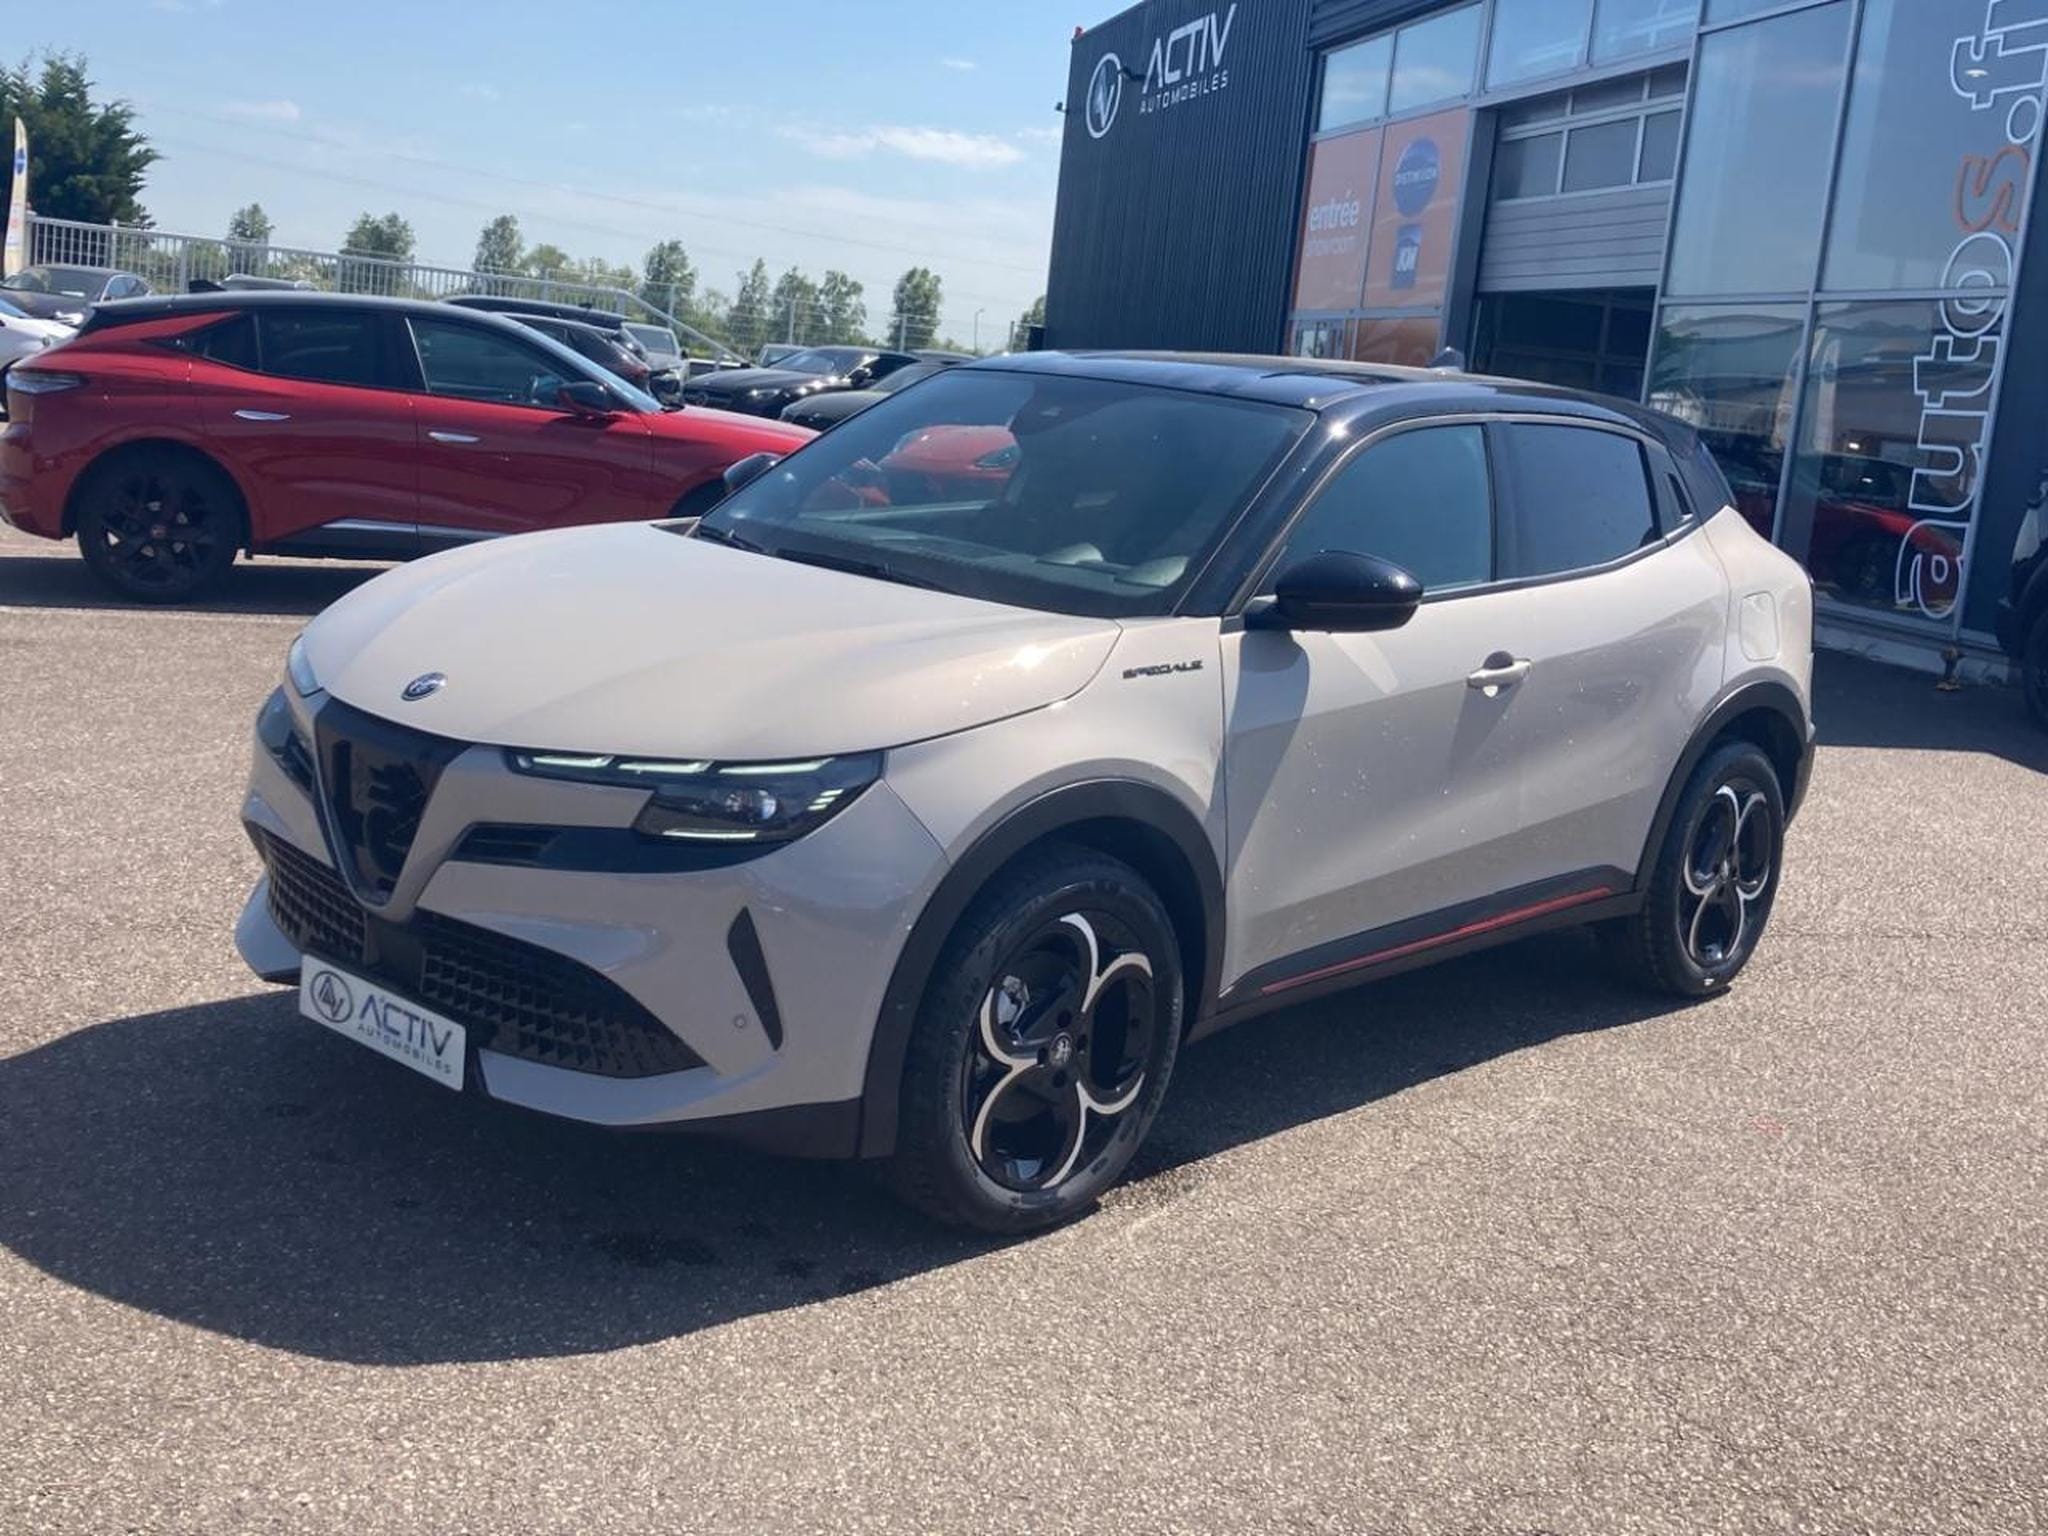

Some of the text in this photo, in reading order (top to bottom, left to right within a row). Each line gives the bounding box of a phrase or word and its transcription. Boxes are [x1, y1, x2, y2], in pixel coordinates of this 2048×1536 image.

[1142, 3, 1237, 94] ACTIV
[1140, 69, 1229, 113] AUTOMOBILES
[1309, 190, 1359, 231] entrée
[357, 1023, 453, 1075] AUTOMOBILES
[359, 994, 453, 1057] ACTIV
